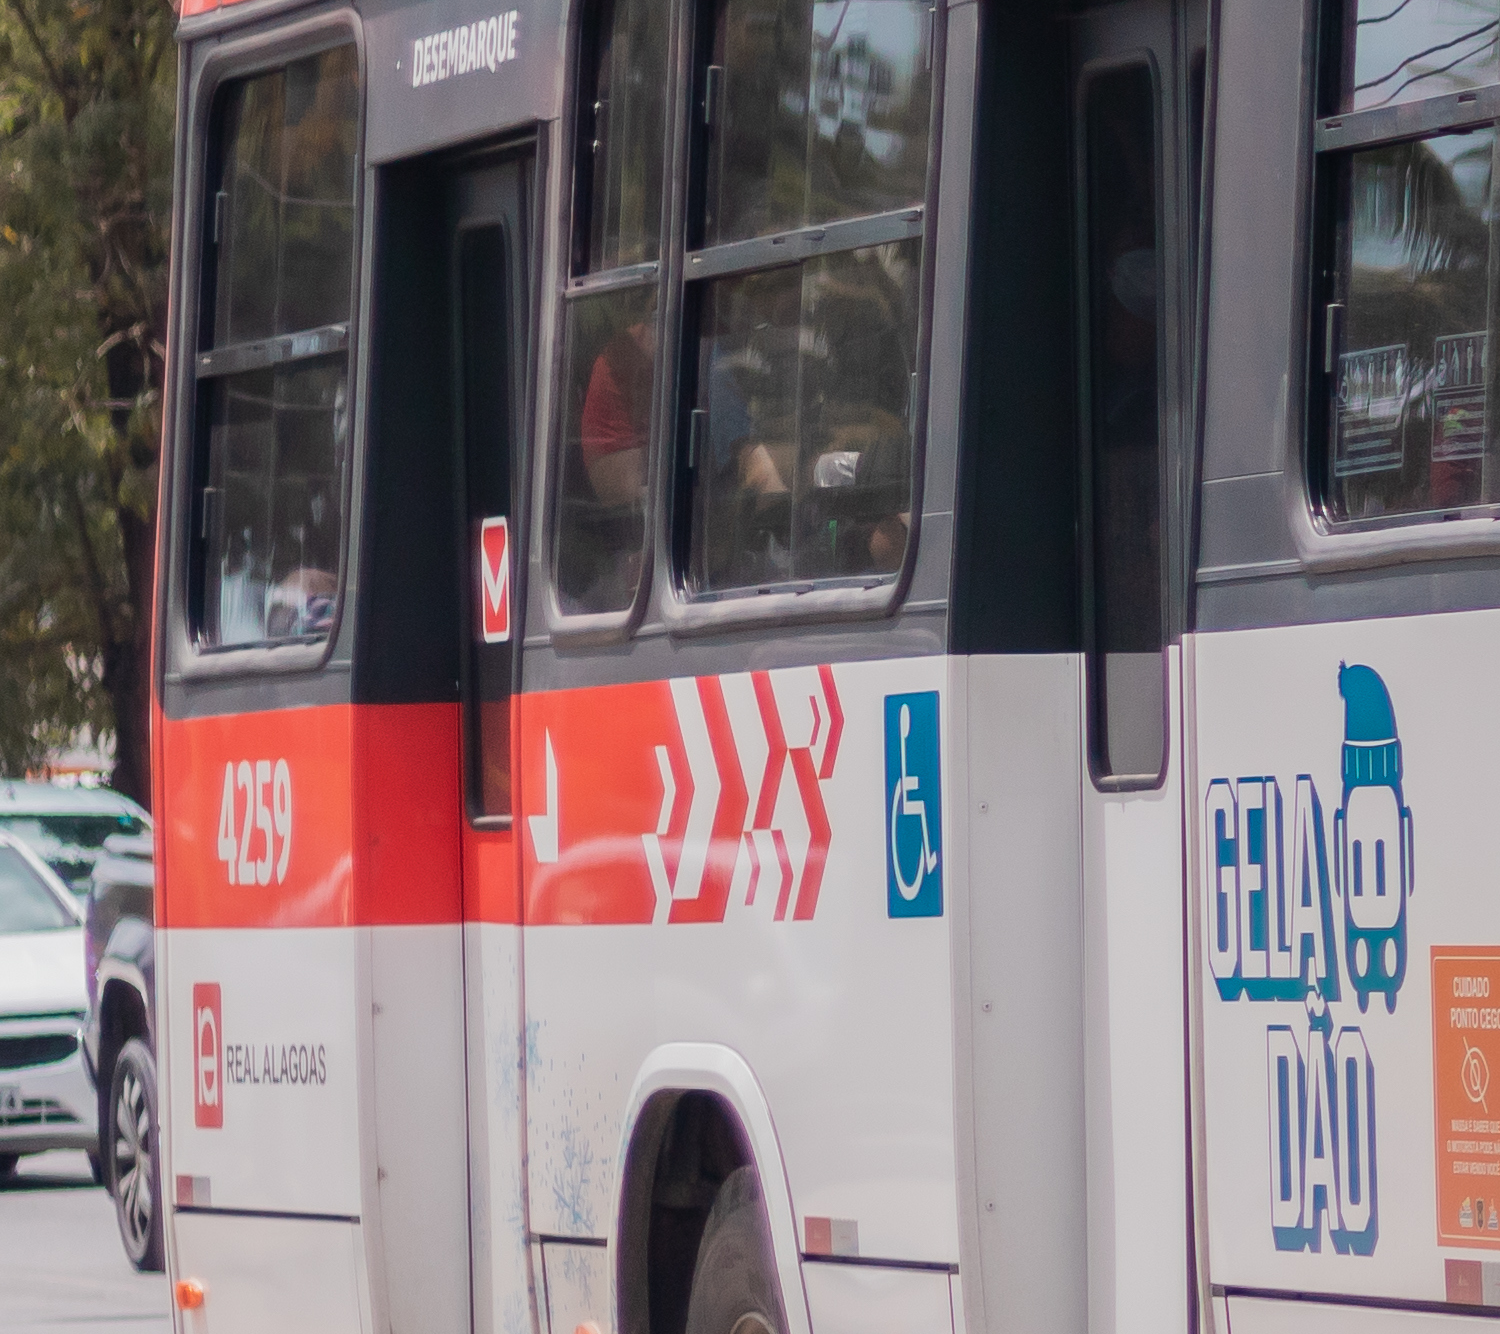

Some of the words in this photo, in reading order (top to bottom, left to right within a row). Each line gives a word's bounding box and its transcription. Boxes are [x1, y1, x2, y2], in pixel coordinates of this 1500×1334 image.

[412, 10, 518, 88] DESEMBARQUE
[217, 758, 292, 887] 4259
[1205, 774, 1341, 1003] GELA
[1453, 977, 1490, 998] CUIDADO
[1450, 1008, 1478, 1029] PONTO
[226, 1043, 259, 1084] REAL
[262, 1043, 327, 1085] ALAGOAS
[1490, 1120, 1500, 1134] QUE
